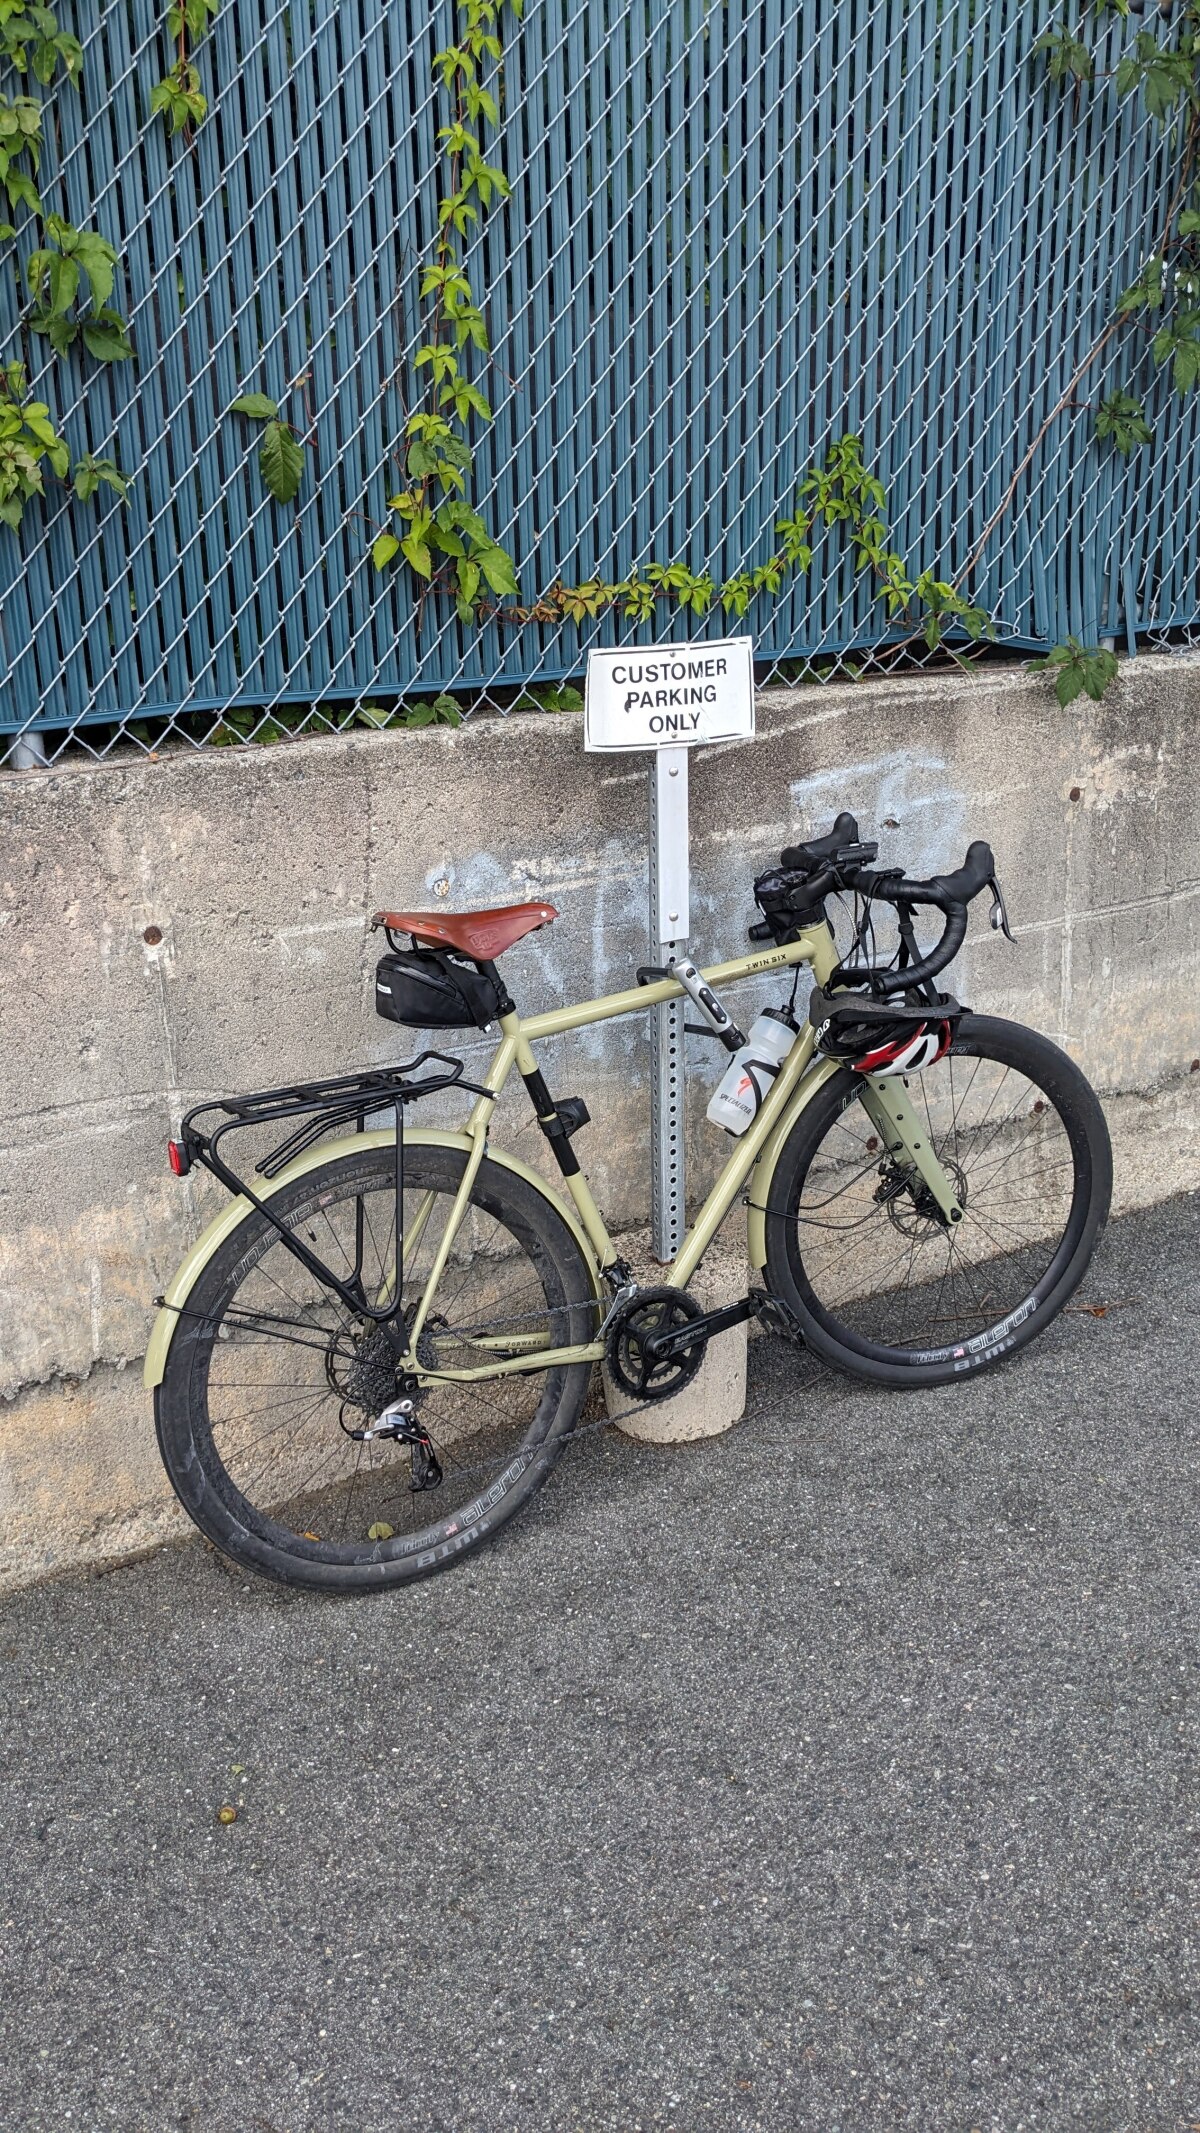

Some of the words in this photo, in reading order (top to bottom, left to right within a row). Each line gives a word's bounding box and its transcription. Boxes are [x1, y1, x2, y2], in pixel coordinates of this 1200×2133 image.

[611, 658, 727, 684] CUSTOMER
[627, 685, 717, 709] PARKING
[649, 712, 701, 733] ONLY
[745, 958, 769, 970] TWIN
[771, 953, 787, 963] SIX
[954, 1342, 1006, 1372] WTB
[417, 1526, 479, 1568] WTB
